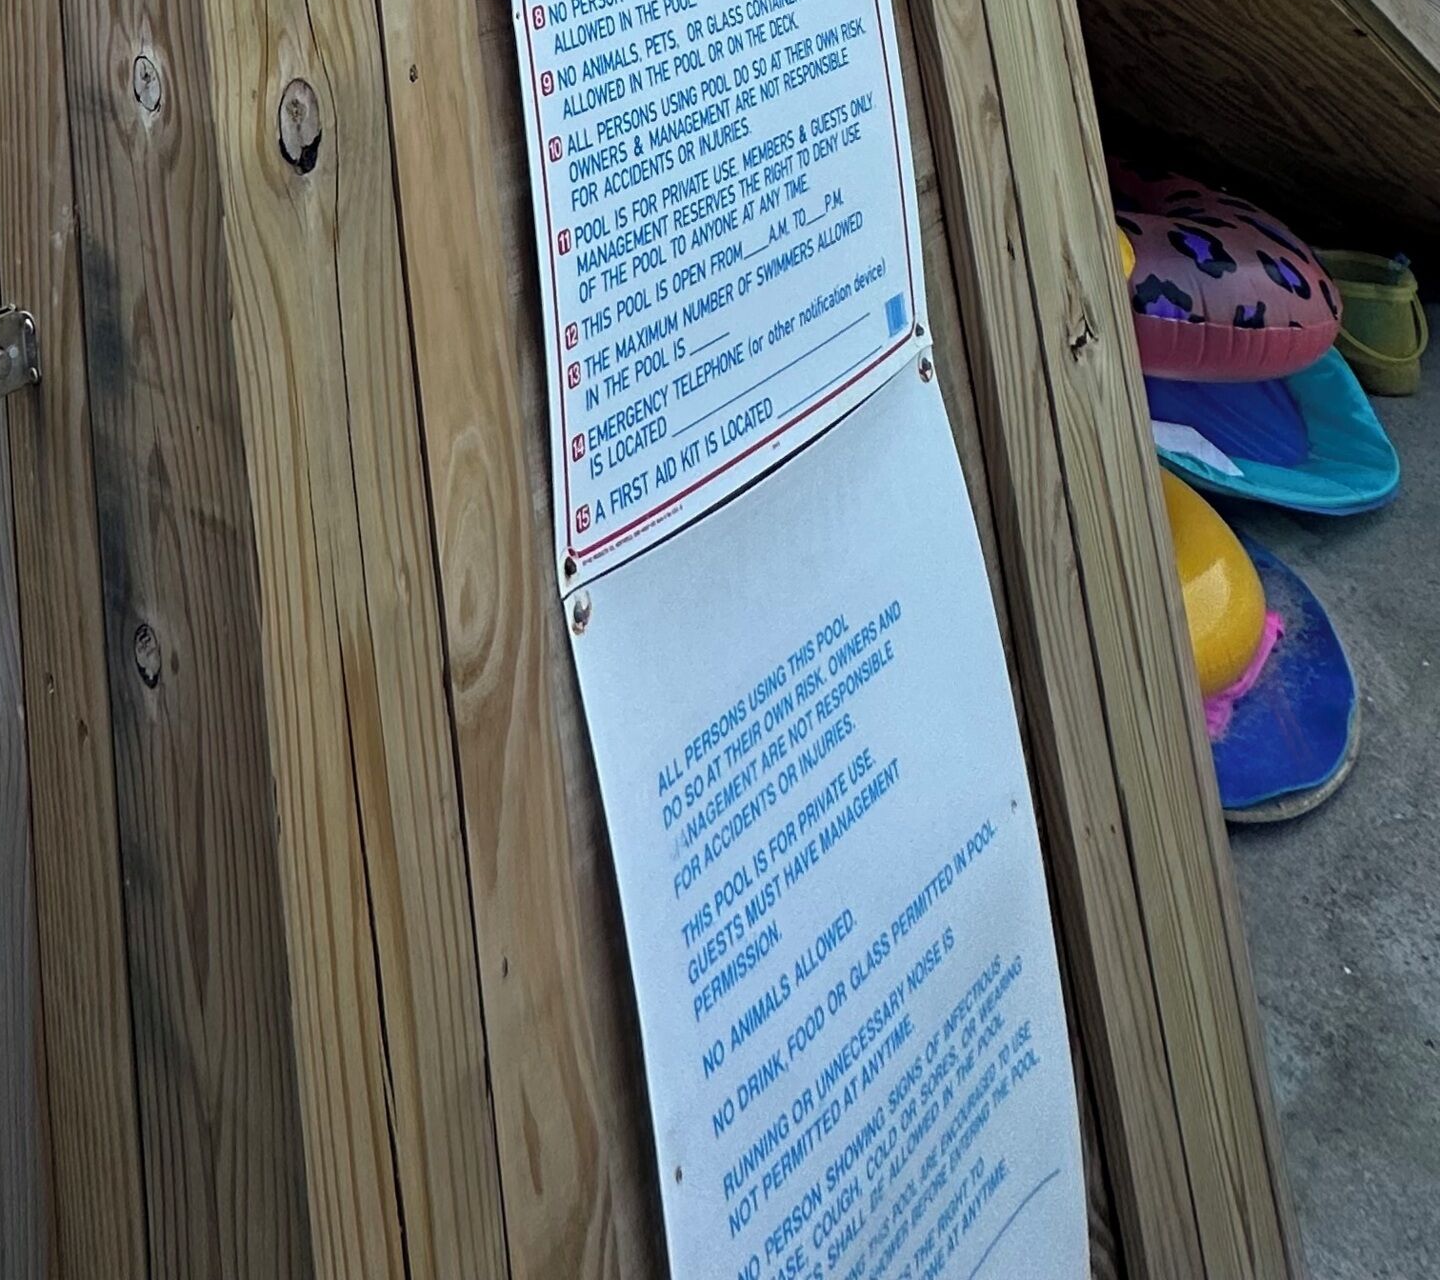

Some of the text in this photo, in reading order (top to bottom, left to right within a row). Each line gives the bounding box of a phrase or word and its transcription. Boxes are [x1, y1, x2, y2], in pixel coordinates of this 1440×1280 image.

[534, 7, 544, 28] 8
[547, 0, 567, 26] NO
[542, 72, 552, 95] 9
[556, 64, 577, 91] NO
[686, 19, 703, 42] OR
[706, 4, 743, 35] GLASS
[568, 46, 849, 183] OWNERS & MANAGEMENT ARE NOT RESPONSIBLE
[571, 181, 598, 211] FOR
[603, 148, 674, 198] ACCIDENTS
[677, 140, 695, 164] OR
[576, 121, 861, 276] MANAGEMENT RESERVES THE RIGHT TO DENY USE
[568, 210, 862, 388] 13 THE MAXIMUM NUMBER OF SWIMMERS ALLOWED
[572, 435, 585, 461] 14
[587, 384, 668, 452] EMERGENCY
[671, 341, 744, 400] TELEPHONE
[767, 316, 795, 345] other
[798, 283, 852, 327] notification
[853, 257, 885, 292] device)
[585, 336, 685, 411] IN THE POOL IS
[577, 397, 772, 532] 15 A FIRST AID KIT IS LOCATED
[589, 415, 666, 480] IS LOCATED
[658, 613, 849, 797] ALL PERSONS USING THIS POOL
[673, 853, 701, 899] FOR
[704, 781, 777, 868] ACCIDENTS
[777, 762, 798, 795] OR
[681, 902, 713, 948] THIS
[713, 865, 753, 916] POOL
[752, 847, 768, 878] IS
[768, 820, 797, 862] FOR
[797, 771, 848, 835] PRIVATE
[702, 1039, 724, 1079] NO
[730, 973, 791, 1052] ANIMALS
[712, 1097, 734, 1139] NO
[786, 1004, 824, 1061] FOOD
[826, 980, 847, 1016] OR
[849, 931, 890, 991] GLASS
[890, 863, 953, 944] PERMITTED
[952, 847, 967, 874] IN
[728, 1184, 758, 1239] NOT
[761, 1098, 841, 1200] PERMITTED
[843, 1075, 857, 1112] AT
